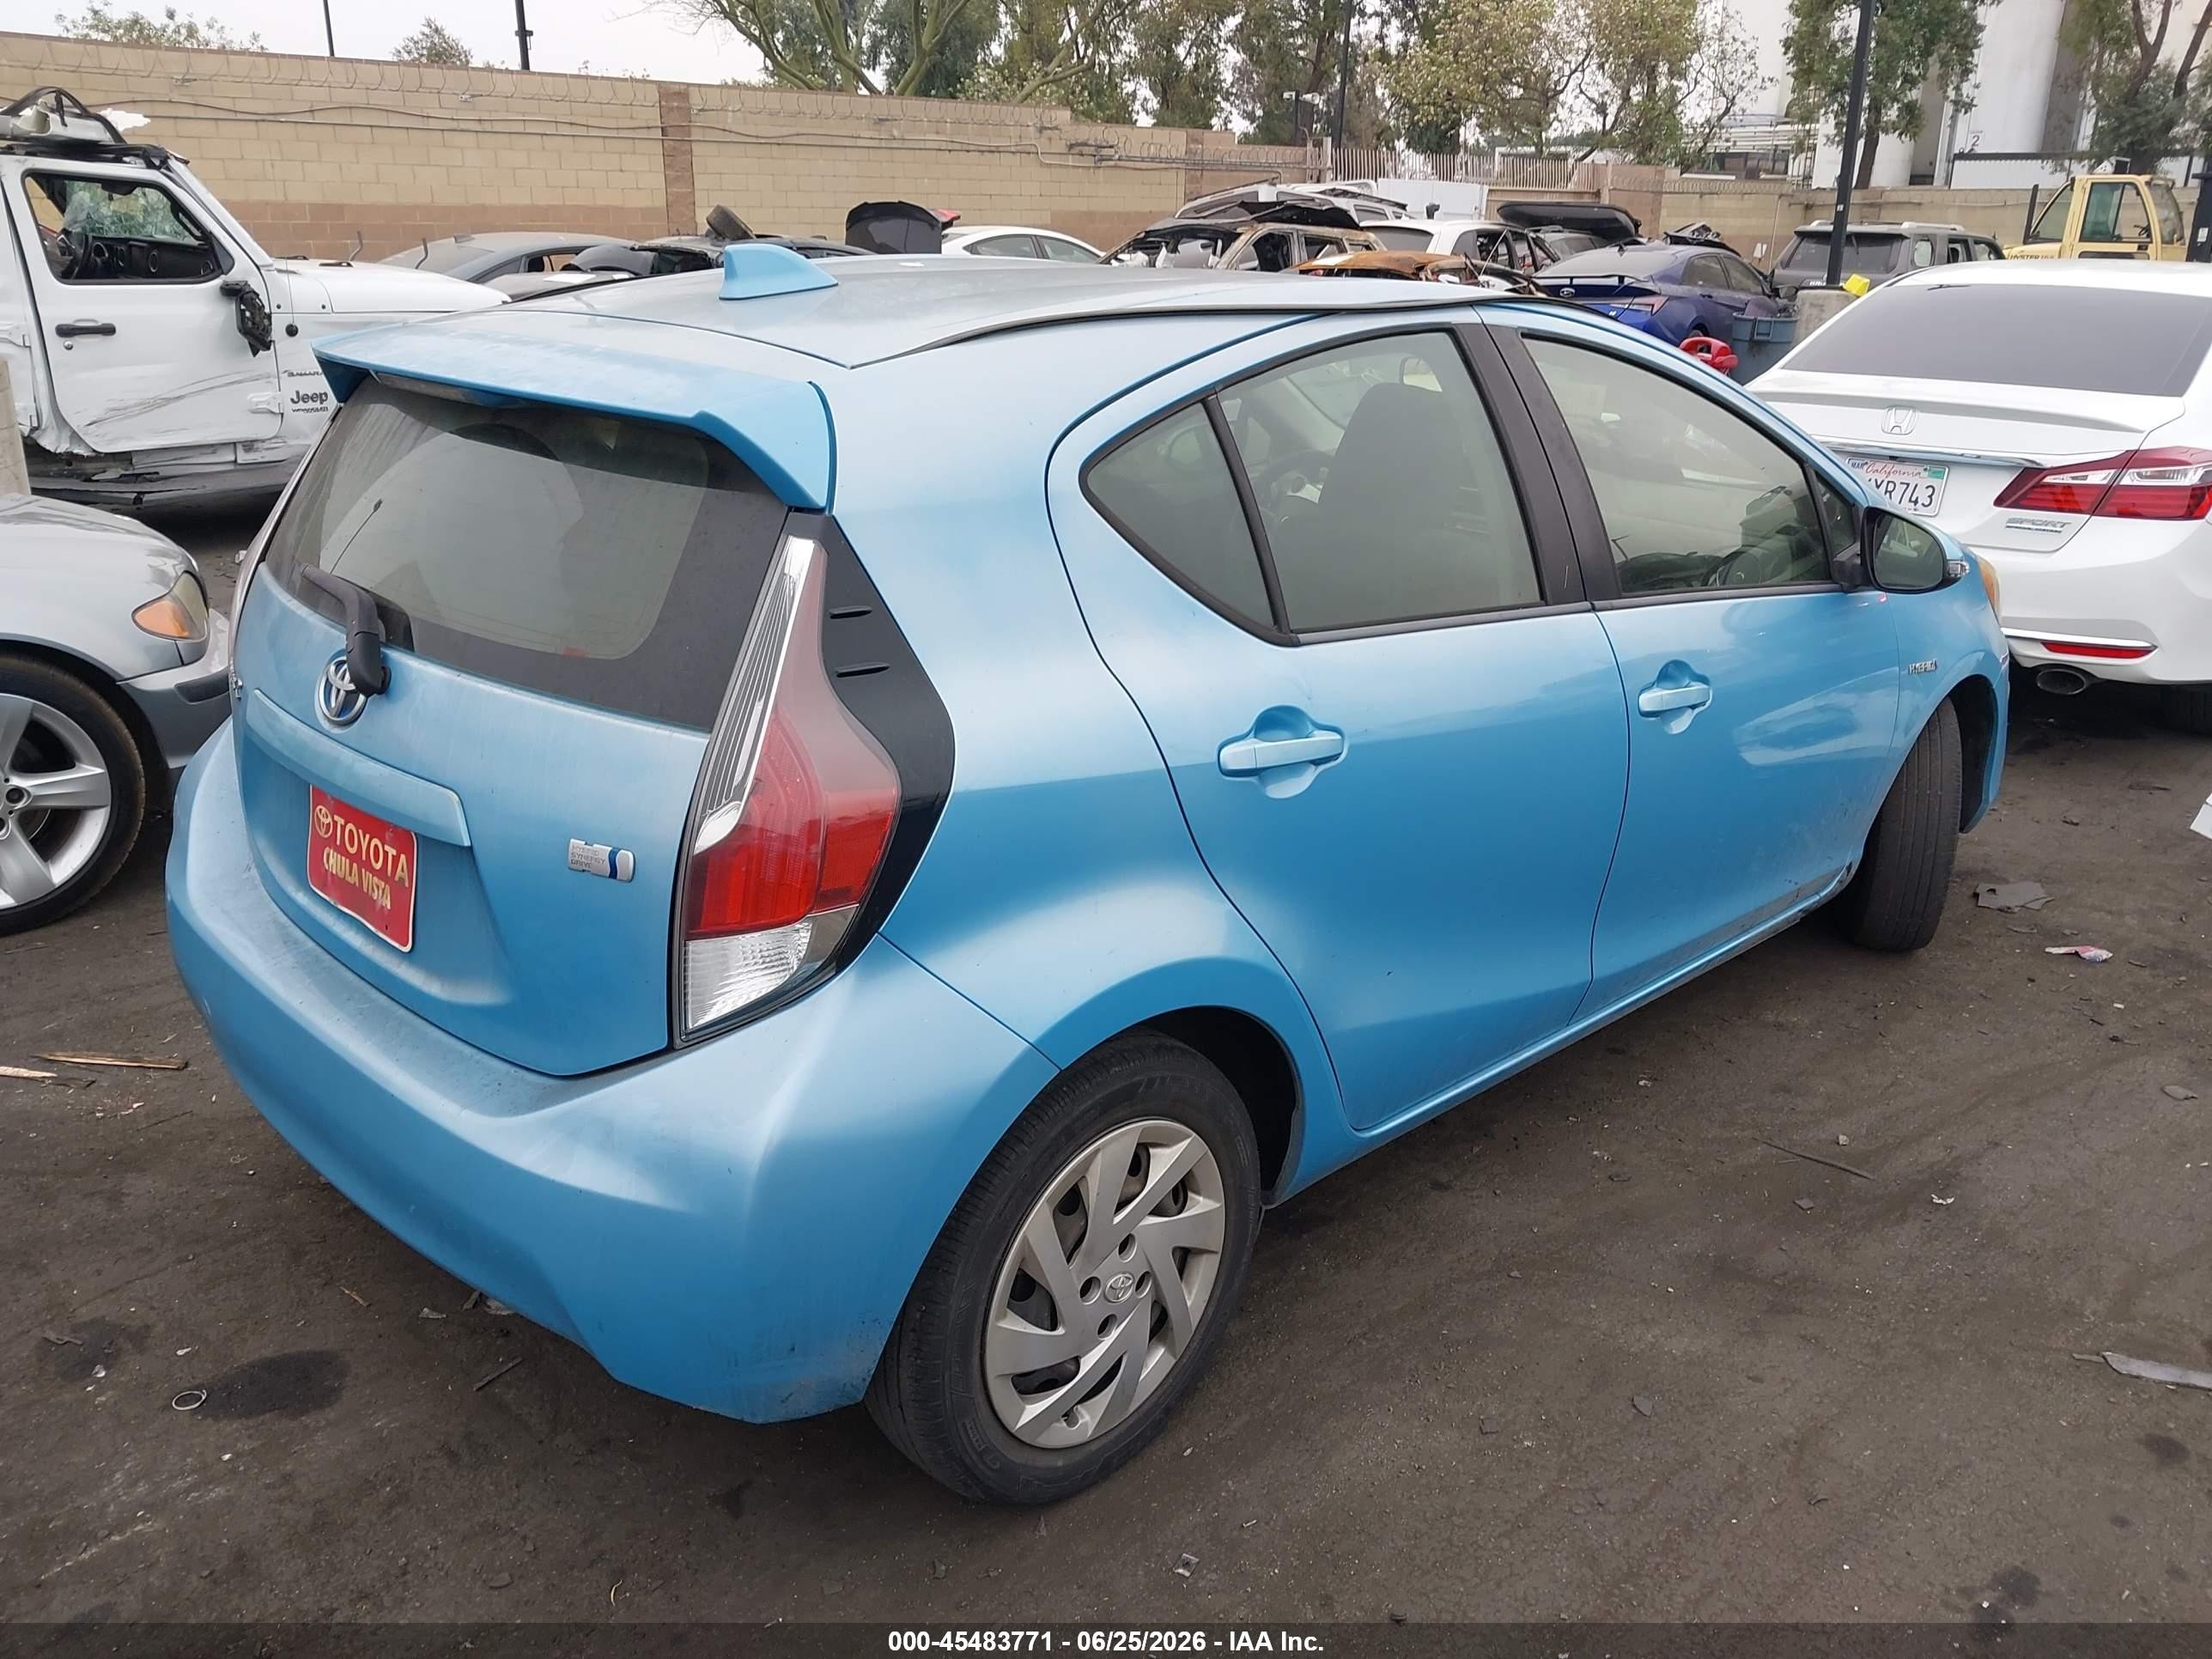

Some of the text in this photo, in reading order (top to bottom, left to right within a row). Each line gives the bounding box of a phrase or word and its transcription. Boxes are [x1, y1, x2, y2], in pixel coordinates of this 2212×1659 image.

[1972, 134, 1980, 147] 2
[289, 390, 328, 404] Jeep
[1865, 462, 1923, 479] California
[334, 815, 410, 888] TOYOTA
[324, 847, 392, 910] CHULA VISTA
